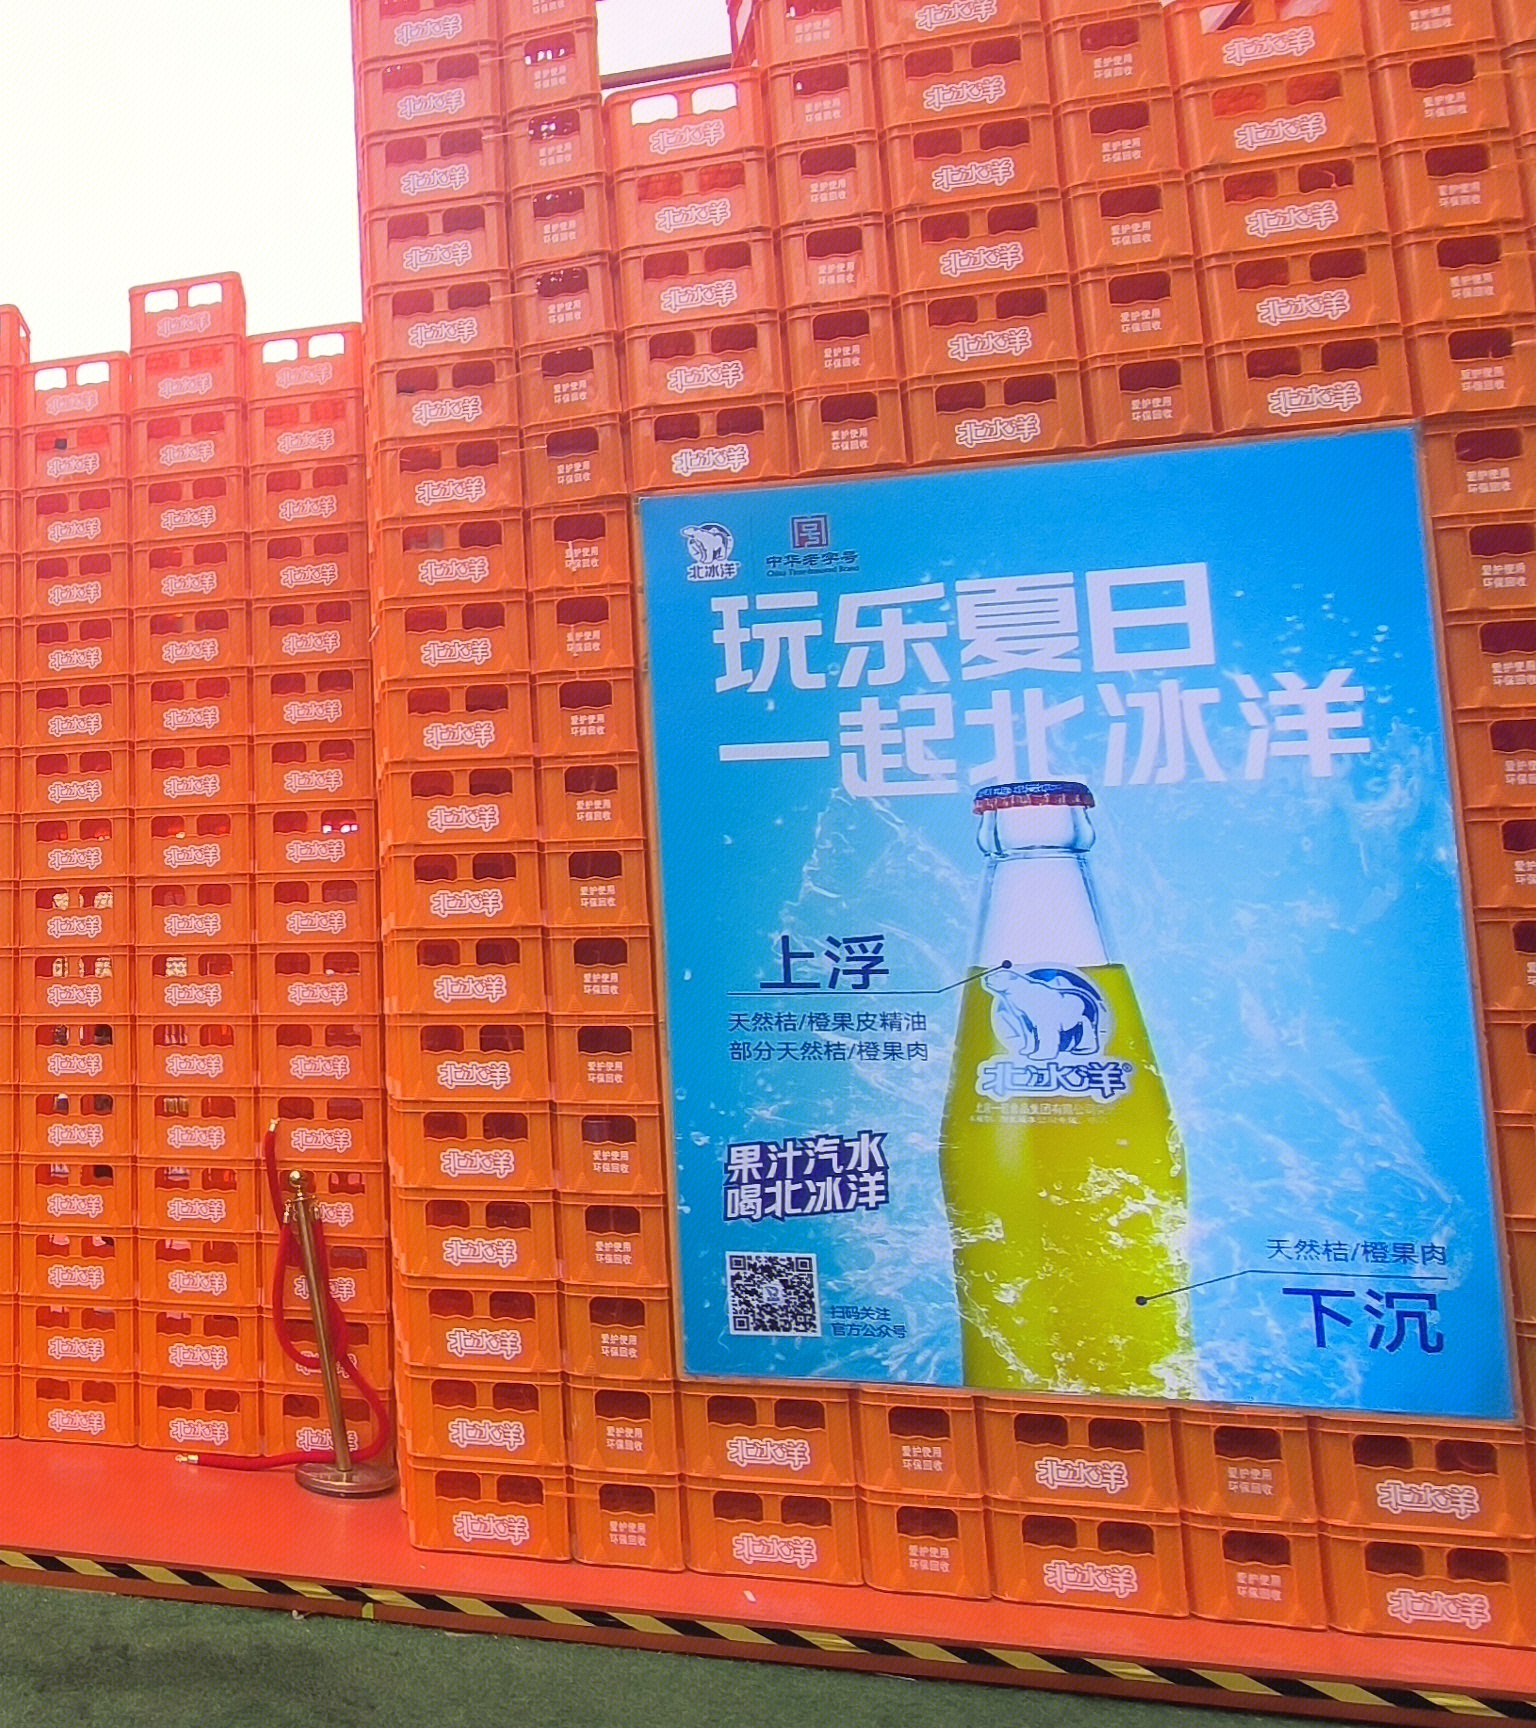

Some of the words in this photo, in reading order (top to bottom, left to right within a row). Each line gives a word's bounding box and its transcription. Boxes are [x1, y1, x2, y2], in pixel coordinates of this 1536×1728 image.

[397, 89, 465, 120] 北冰洋
[924, 76, 1005, 110] 北冰洋
[1234, 113, 1326, 150] 北冰洋
[401, 165, 469, 195] 北冰洋
[932, 158, 1014, 191] 北冰洋
[654, 199, 731, 236] 北冰洋
[1246, 201, 1338, 236] 北冰洋
[403, 241, 472, 270] 北冰洋
[940, 243, 1023, 276] 北冰洋
[661, 281, 737, 311] 北冰洋
[1257, 290, 1350, 324] 北冰洋
[408, 318, 477, 347] 北冰洋
[948, 327, 1032, 360] 北冰洋
[667, 361, 744, 393] 北冰洋
[413, 396, 482, 427] 北冰洋
[1268, 382, 1361, 415] 北冰洋
[956, 414, 1040, 446] 北冰洋
[672, 445, 749, 475] 北冰洋
[416, 477, 486, 505] 北冰洋
[419, 557, 489, 584] 北冰洋
[688, 562, 736, 580] 北冰洋
[765, 550, 859, 568] 中华老字号
[712, 561, 1217, 694] 玩乐夏日
[421, 638, 491, 665] 北冰洋
[424, 721, 495, 748] 北冰洋
[719, 668, 1373, 799] 一起北冰洋
[428, 805, 499, 832] 北冰洋
[430, 889, 503, 917] 北冰洋
[760, 935, 889, 989] 上浮
[434, 975, 507, 1003] 北冰洋
[728, 1011, 927, 1032] 天然桔/橙果皮精油
[728, 1041, 929, 1062] 部分天然桔/橙果肉
[438, 1061, 511, 1089] 北冰洋
[979, 1060, 1128, 1101] 北冰洋
[441, 1149, 515, 1177] 北冰洋
[726, 1132, 886, 1183] 果汁汽水
[726, 1171, 887, 1219] 喝北冰洋
[443, 1238, 517, 1266] 北冰洋
[1267, 1238, 1446, 1265] 天然桔/橙果肉
[831, 1306, 891, 1321] 扫码关注
[1282, 1288, 1444, 1353] 下沉
[447, 1328, 522, 1358] 北冰洋
[832, 1323, 907, 1339] 官方公众号
[449, 1419, 525, 1450] 北冰洋
[727, 1437, 810, 1469] 北冰洋
[1035, 1457, 1128, 1492] 北冰洋
[1377, 1480, 1479, 1517] 北冰洋
[453, 1512, 529, 1544] 北冰洋
[733, 1534, 817, 1567] 北冰洋
[1044, 1560, 1138, 1596] 北冰洋
[1387, 1589, 1490, 1627] 北冰洋
